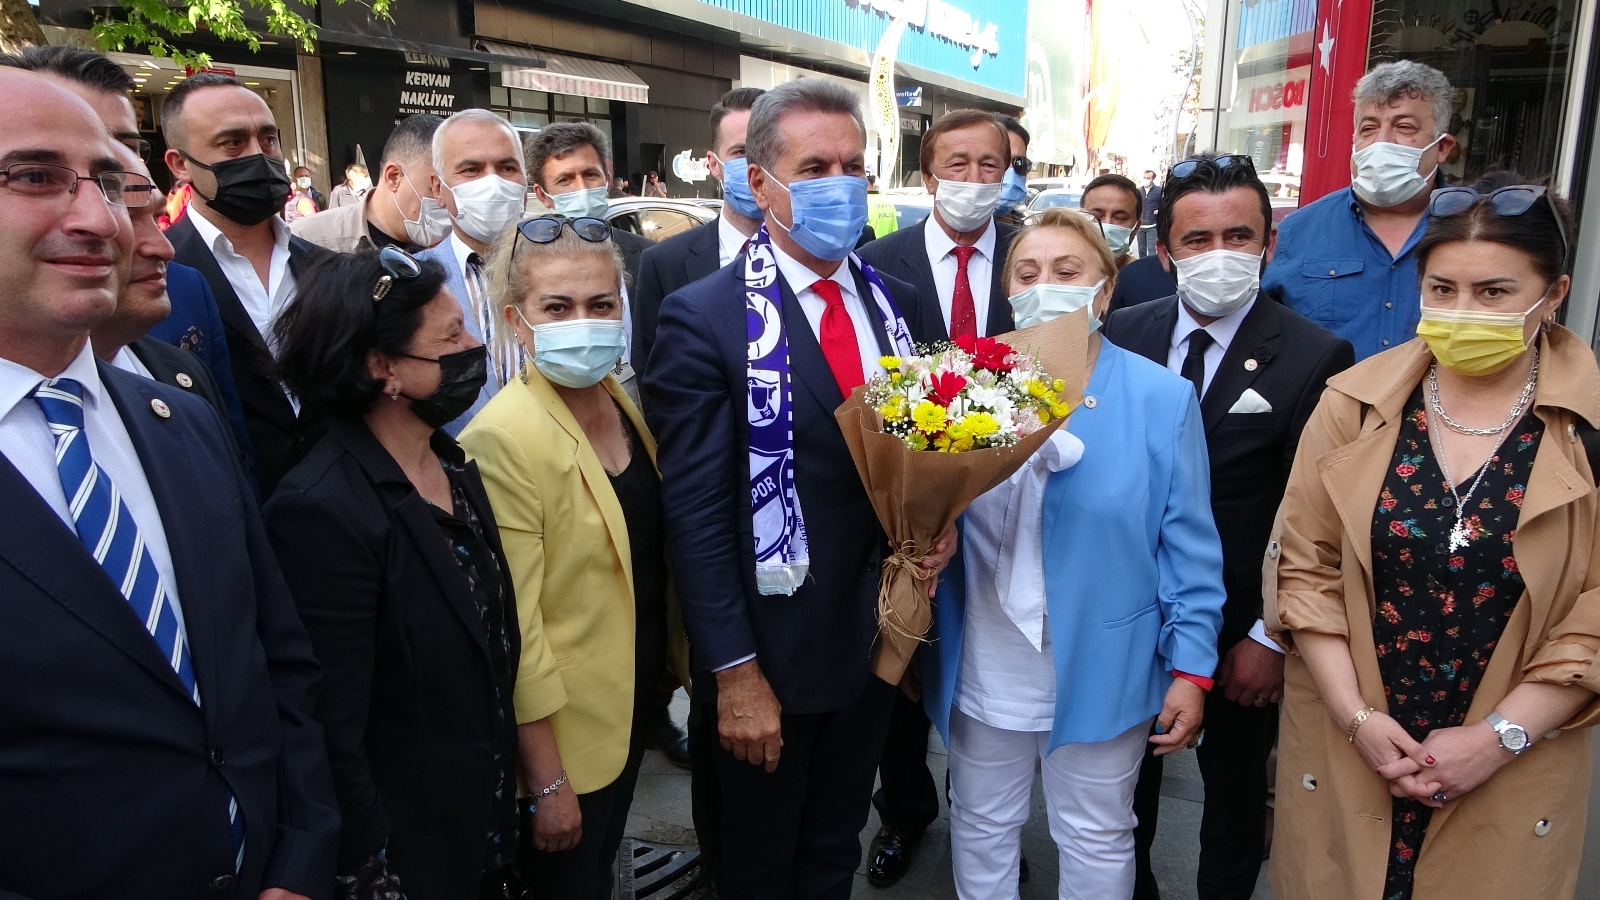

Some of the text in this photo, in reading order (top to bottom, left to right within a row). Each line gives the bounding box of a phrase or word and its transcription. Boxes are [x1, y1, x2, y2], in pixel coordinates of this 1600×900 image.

[405, 71, 451, 88] KERVAN
[401, 89, 455, 108] NAKLİYAT
[751, 476, 777, 508] POR
